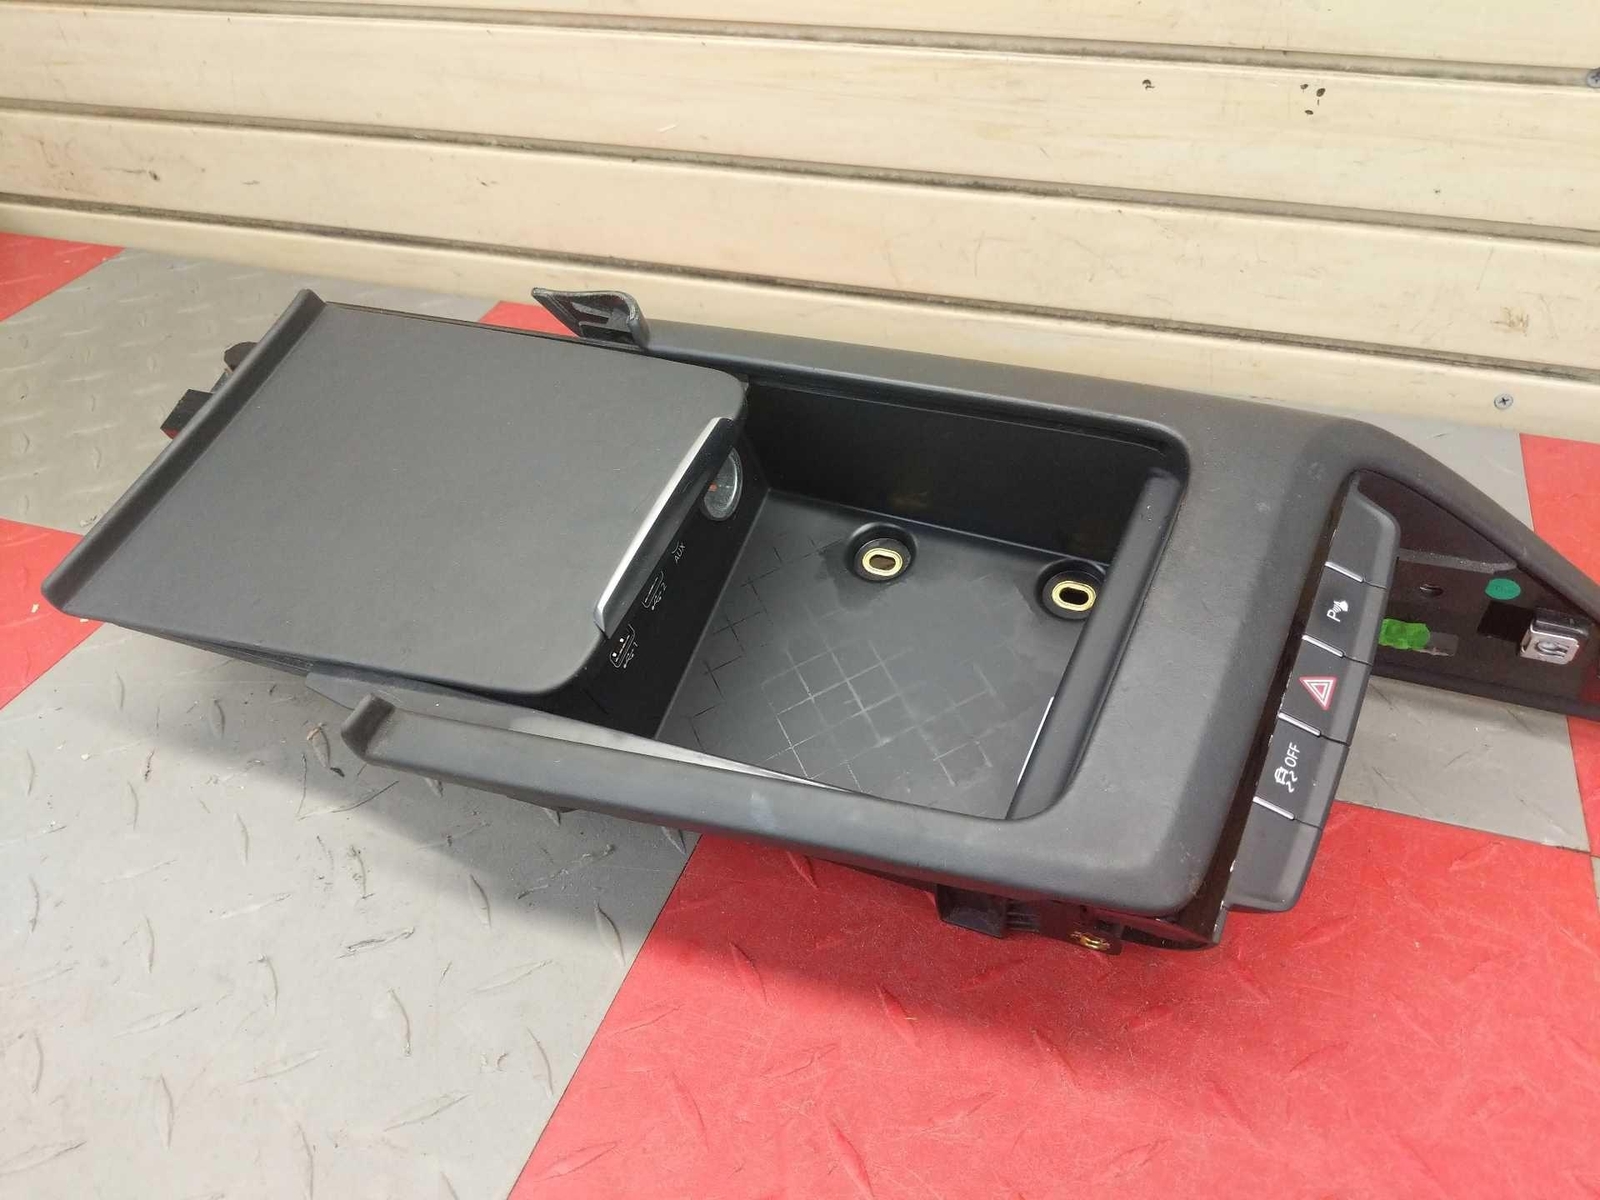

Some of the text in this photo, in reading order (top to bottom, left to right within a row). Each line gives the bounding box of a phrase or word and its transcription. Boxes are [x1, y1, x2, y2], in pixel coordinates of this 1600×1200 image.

[674, 542, 686, 564] AUX
[1326, 608, 1341, 623] P
[1284, 741, 1301, 768] OFF
